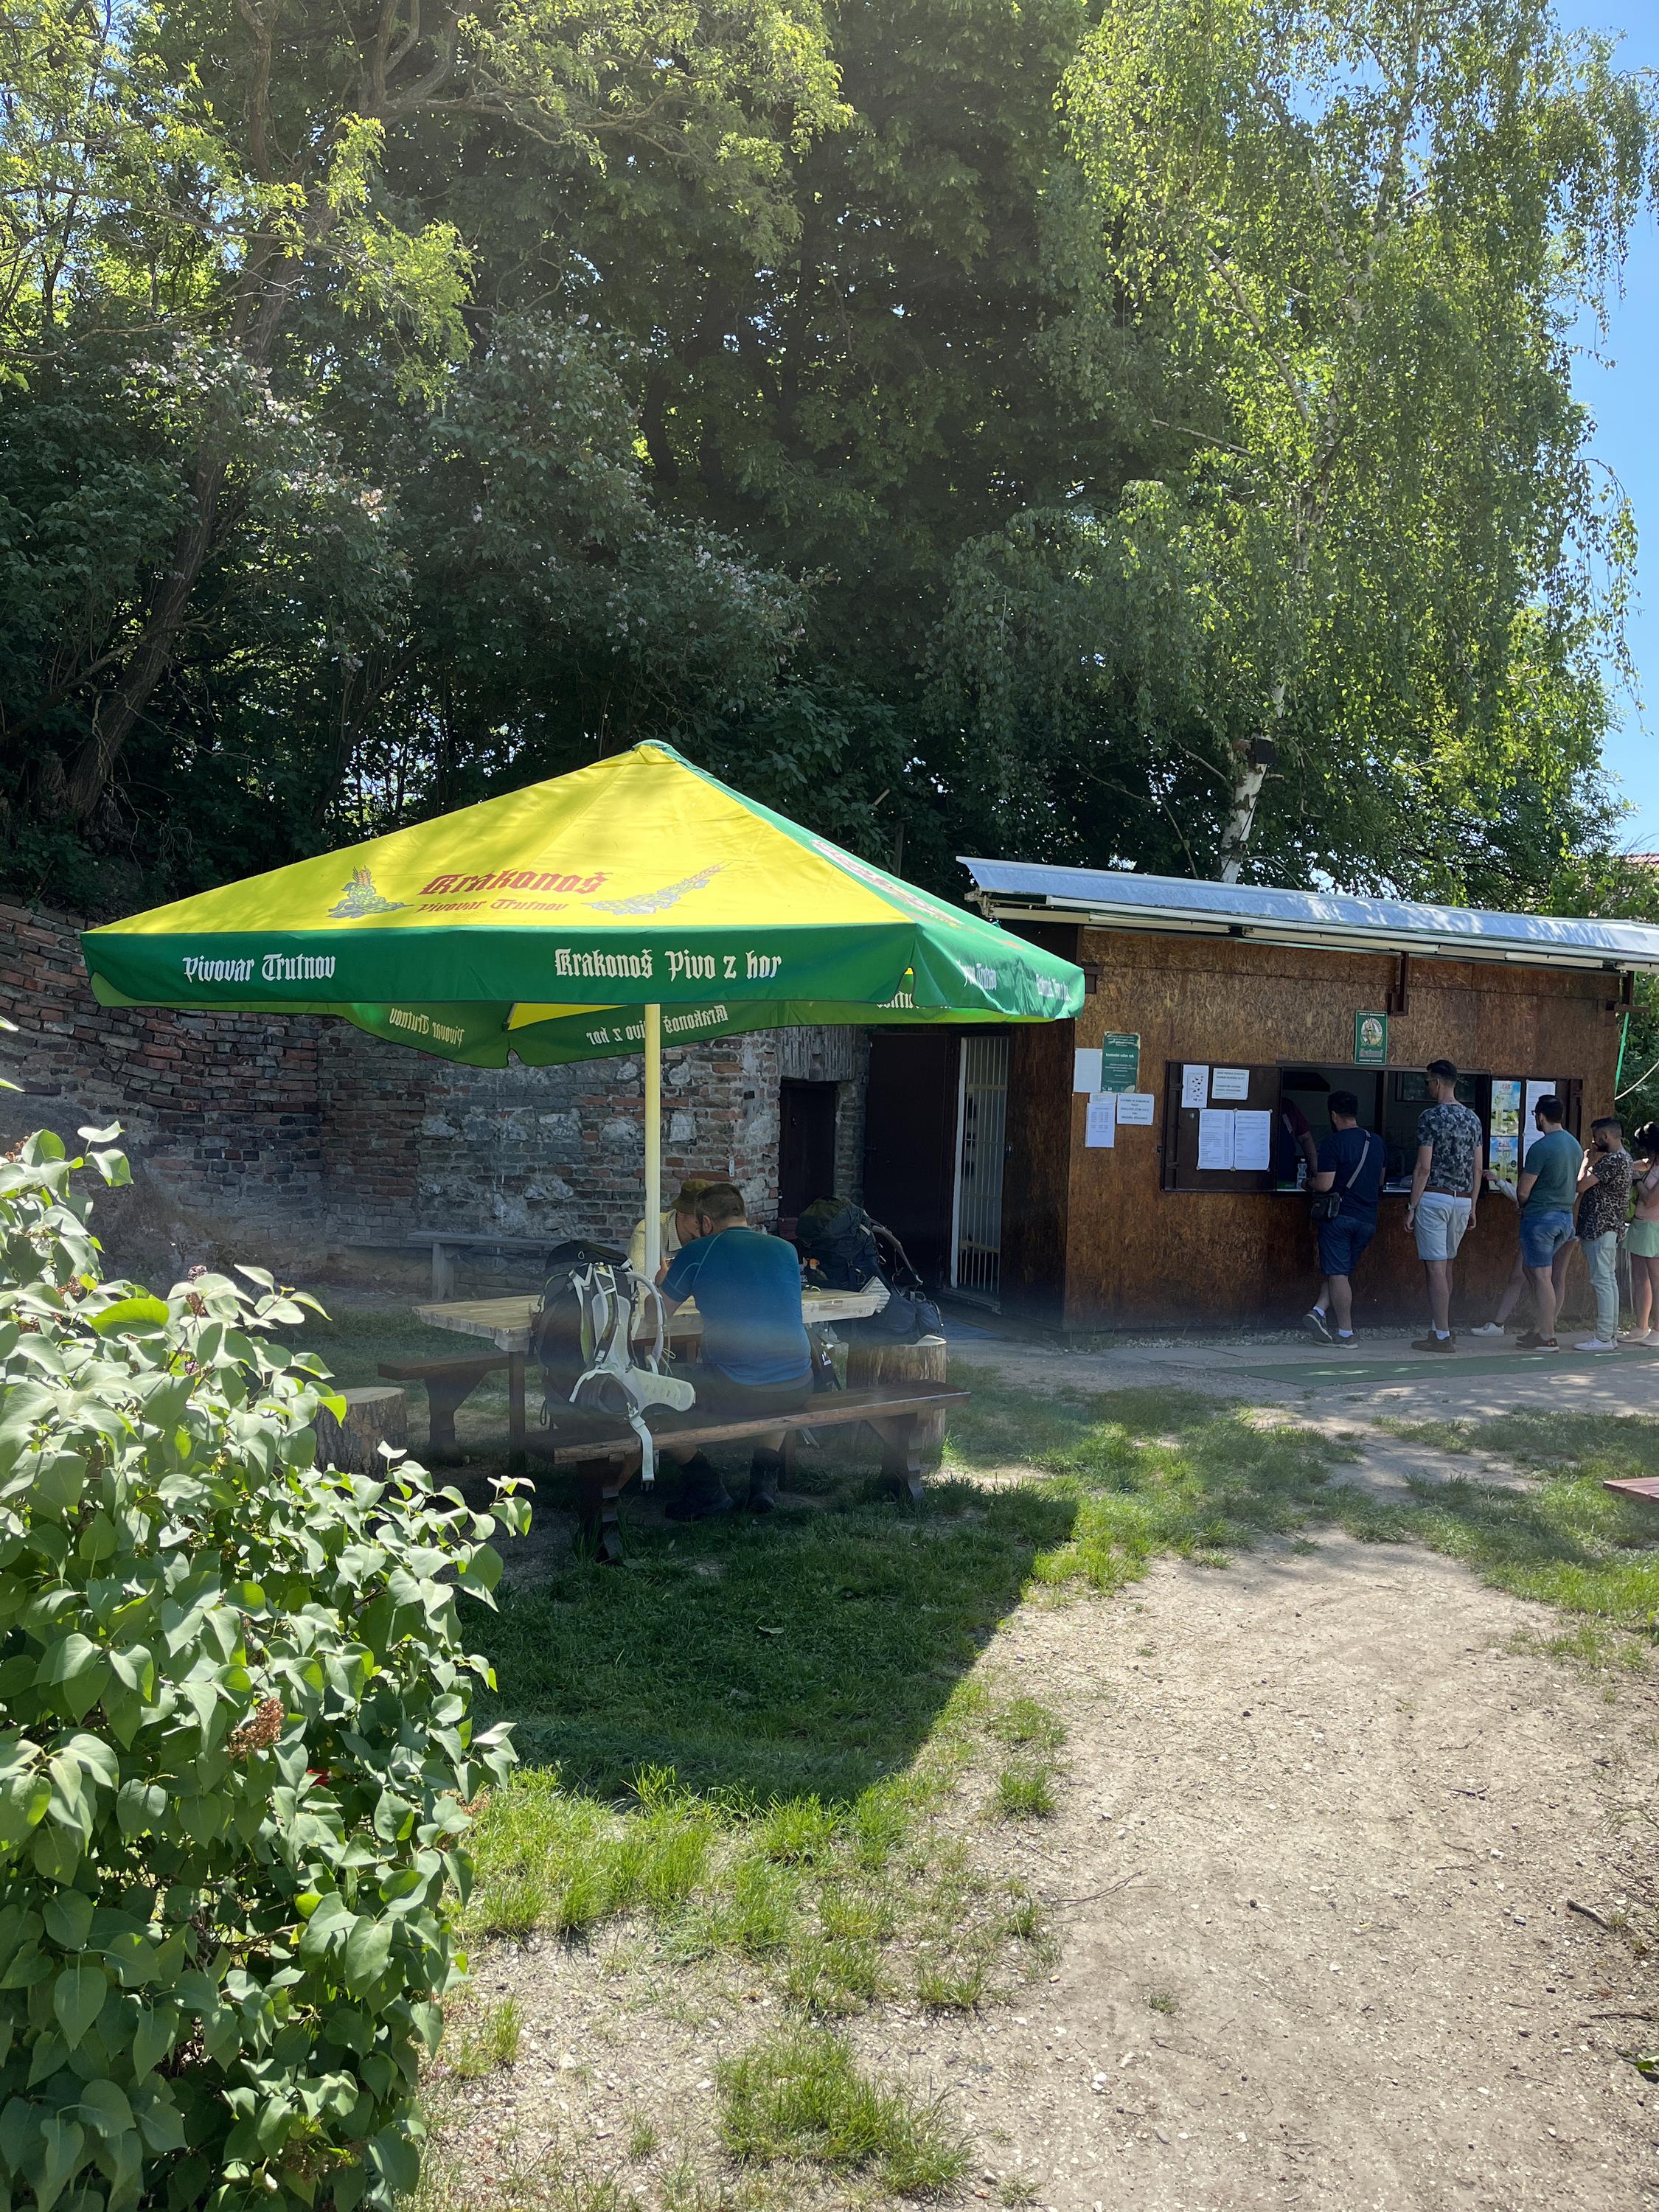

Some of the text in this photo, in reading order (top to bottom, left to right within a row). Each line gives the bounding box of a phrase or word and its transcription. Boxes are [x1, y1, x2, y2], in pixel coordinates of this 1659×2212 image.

[417, 869, 614, 895] Krakonoš
[414, 899, 569, 914] Pivovar Trutnov
[182, 953, 336, 983] Pivovar Trutnov
[554, 948, 782, 982] Krakonoš Pivo z hor
